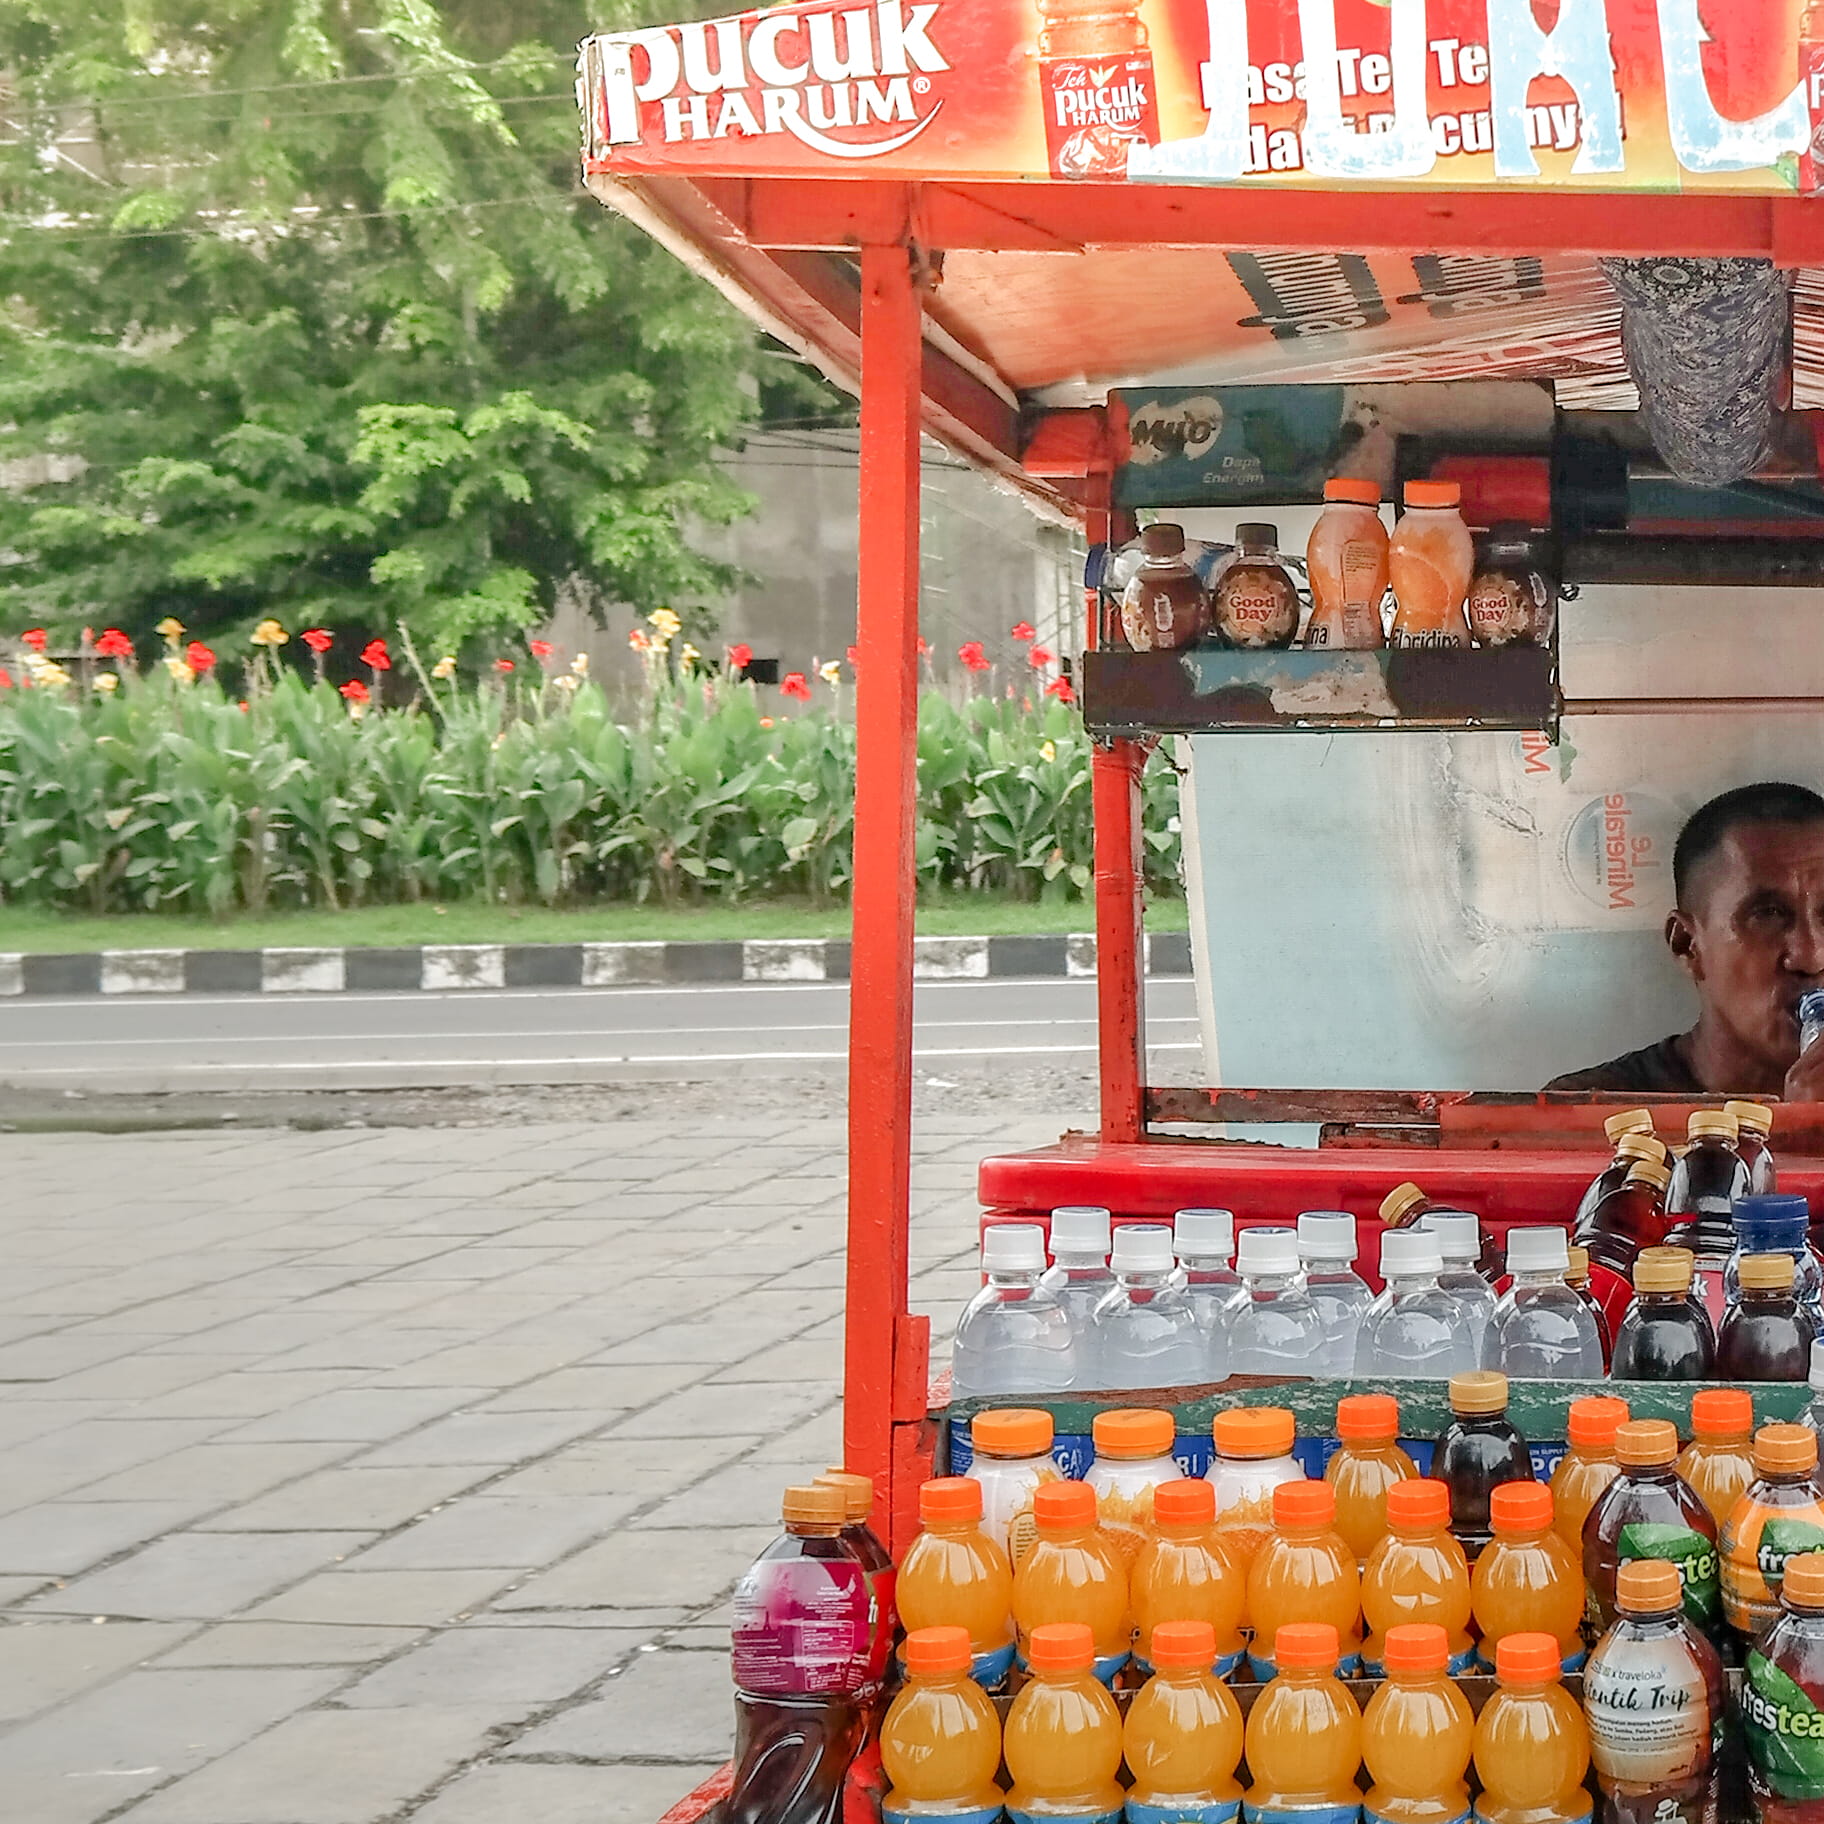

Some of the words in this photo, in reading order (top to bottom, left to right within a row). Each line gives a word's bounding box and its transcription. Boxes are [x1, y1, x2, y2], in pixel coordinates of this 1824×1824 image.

[1335, 47, 1393, 96] Te
[662, 75, 944, 158] HARUM
[1073, 106, 1143, 132] HARUM
[1229, 595, 1276, 608] Good
[1472, 595, 1508, 610] Good
[1236, 608, 1273, 622] Day
[1476, 609, 1506, 623] Day
[1618, 1665, 1662, 1681] traveloka
[1650, 1684, 1691, 1712] Trip
